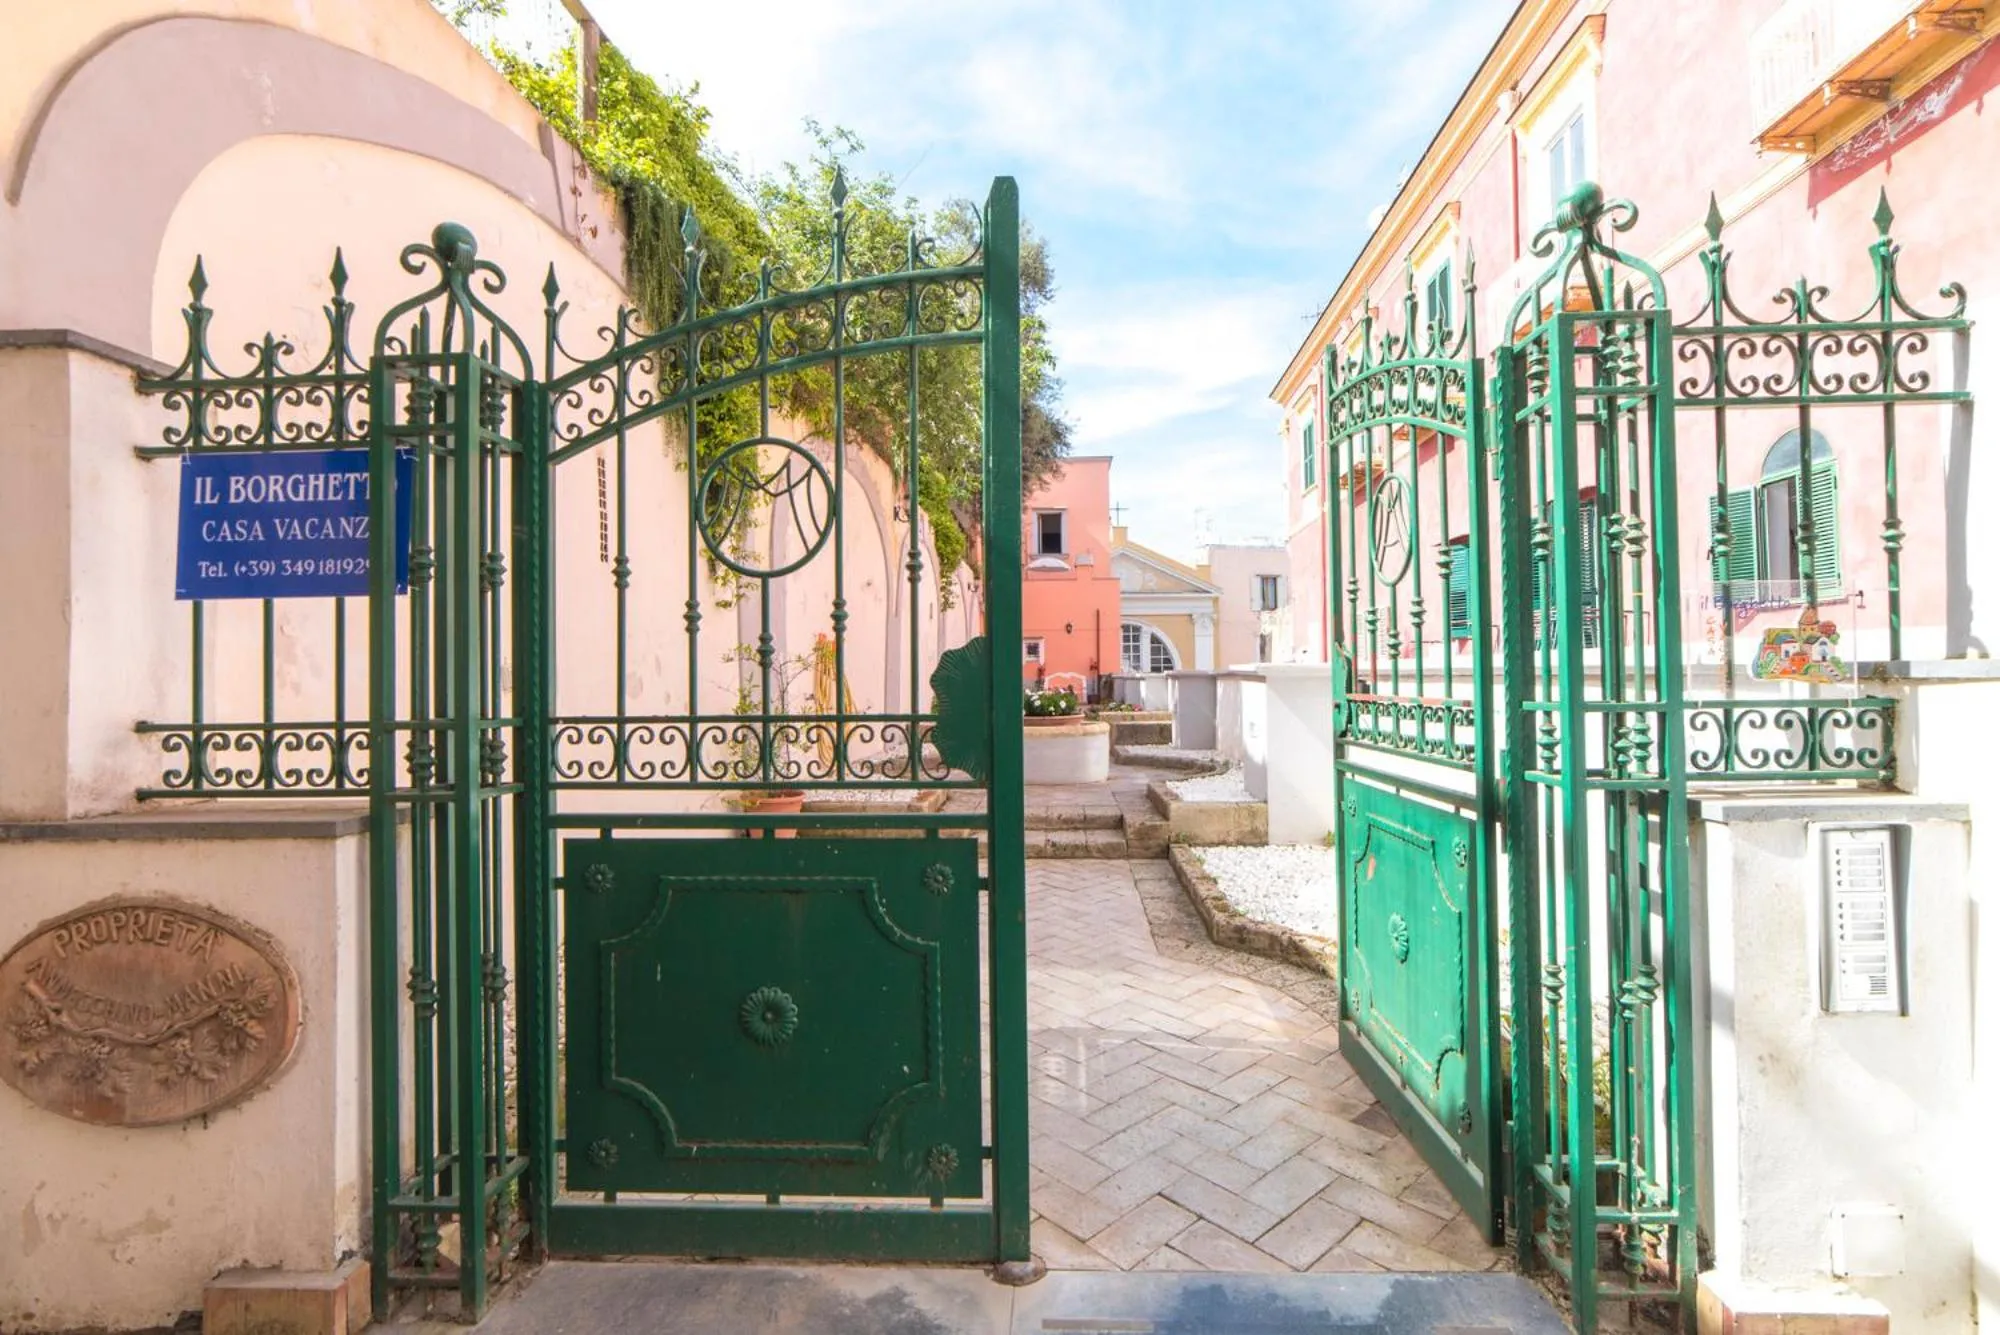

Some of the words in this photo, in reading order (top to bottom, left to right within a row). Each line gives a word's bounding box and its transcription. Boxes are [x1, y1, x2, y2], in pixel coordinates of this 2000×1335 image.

[193, 476, 220, 504] IL
[228, 472, 398, 504] BORGHETT
[202, 519, 265, 542] CASA
[273, 516, 370, 541] VACANZ
[197, 561, 228, 578] Tel.
[234, 559, 276, 577] (+39)
